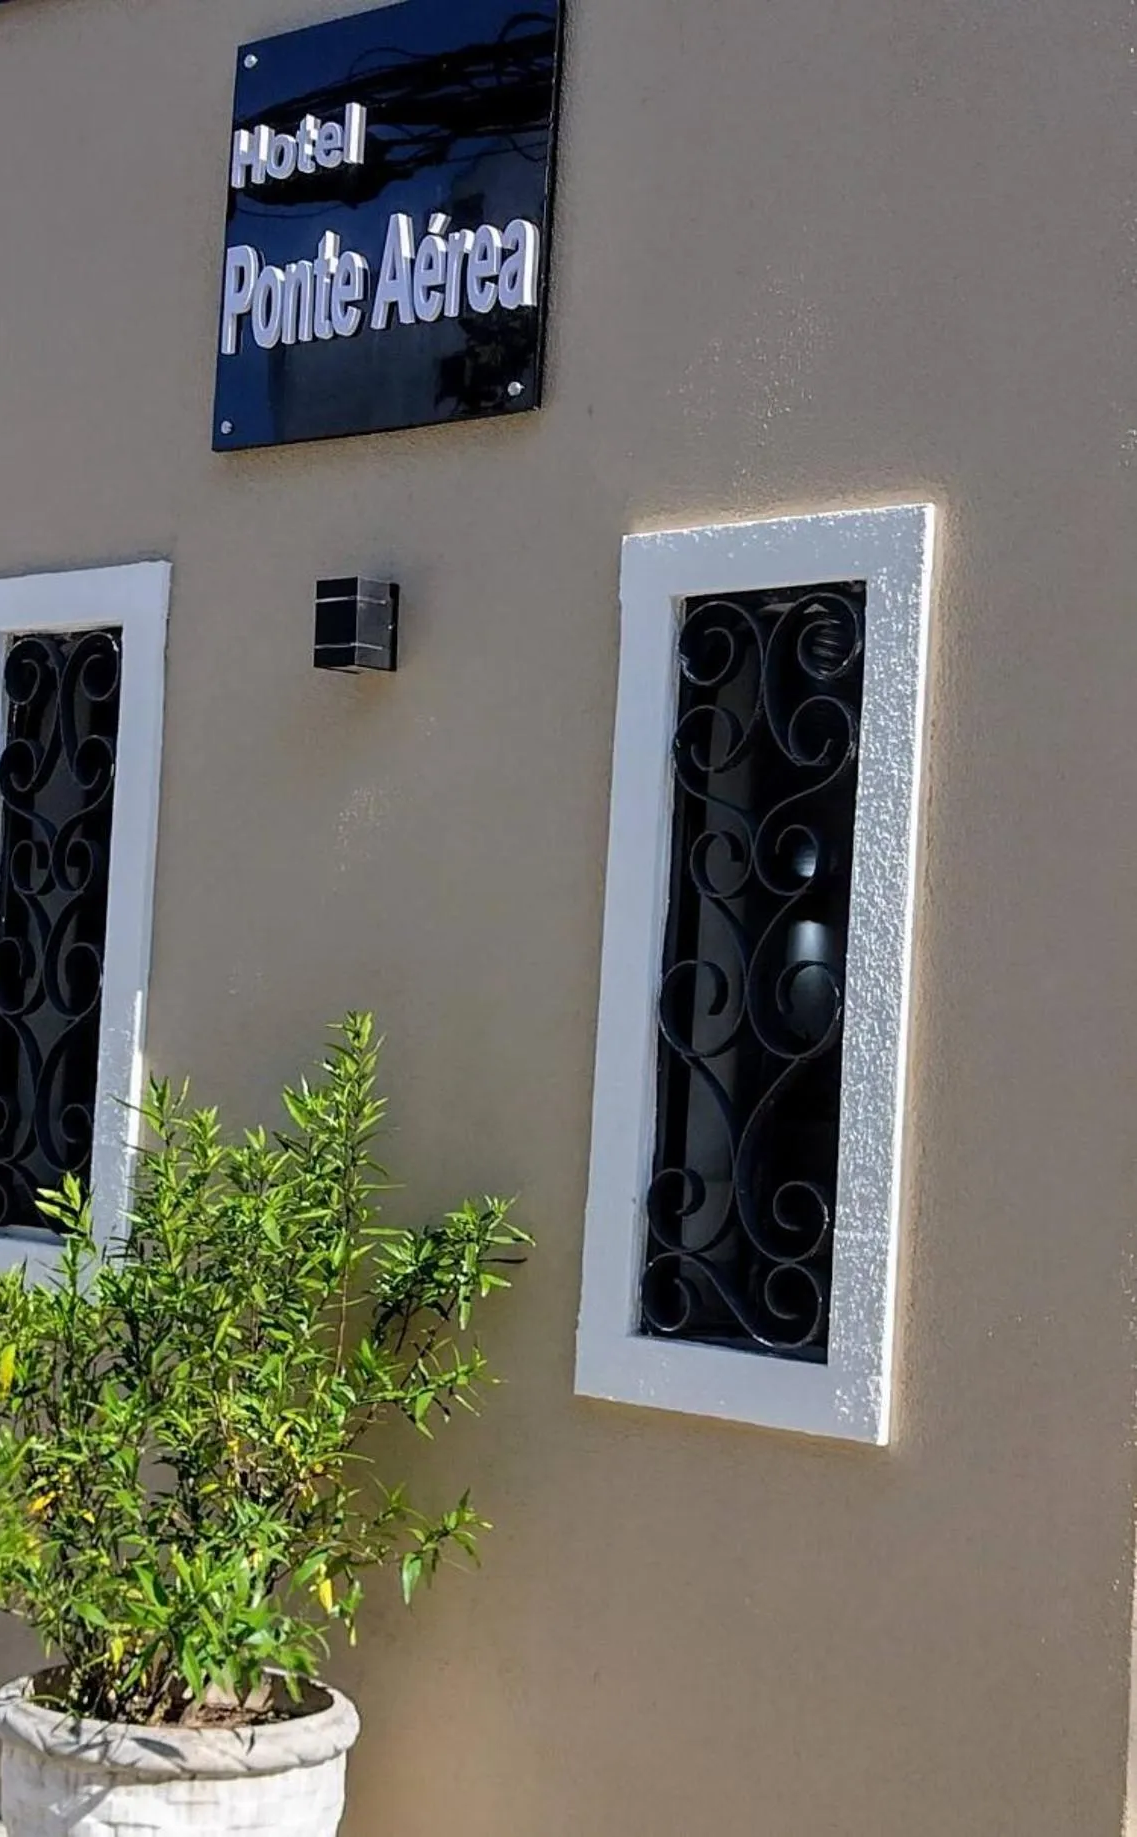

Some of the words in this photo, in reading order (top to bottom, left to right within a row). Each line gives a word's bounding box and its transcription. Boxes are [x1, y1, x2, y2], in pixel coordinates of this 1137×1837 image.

[232, 102, 367, 188] Hotel
[221, 231, 369, 355] Ponte
[371, 213, 539, 330] Aérea
